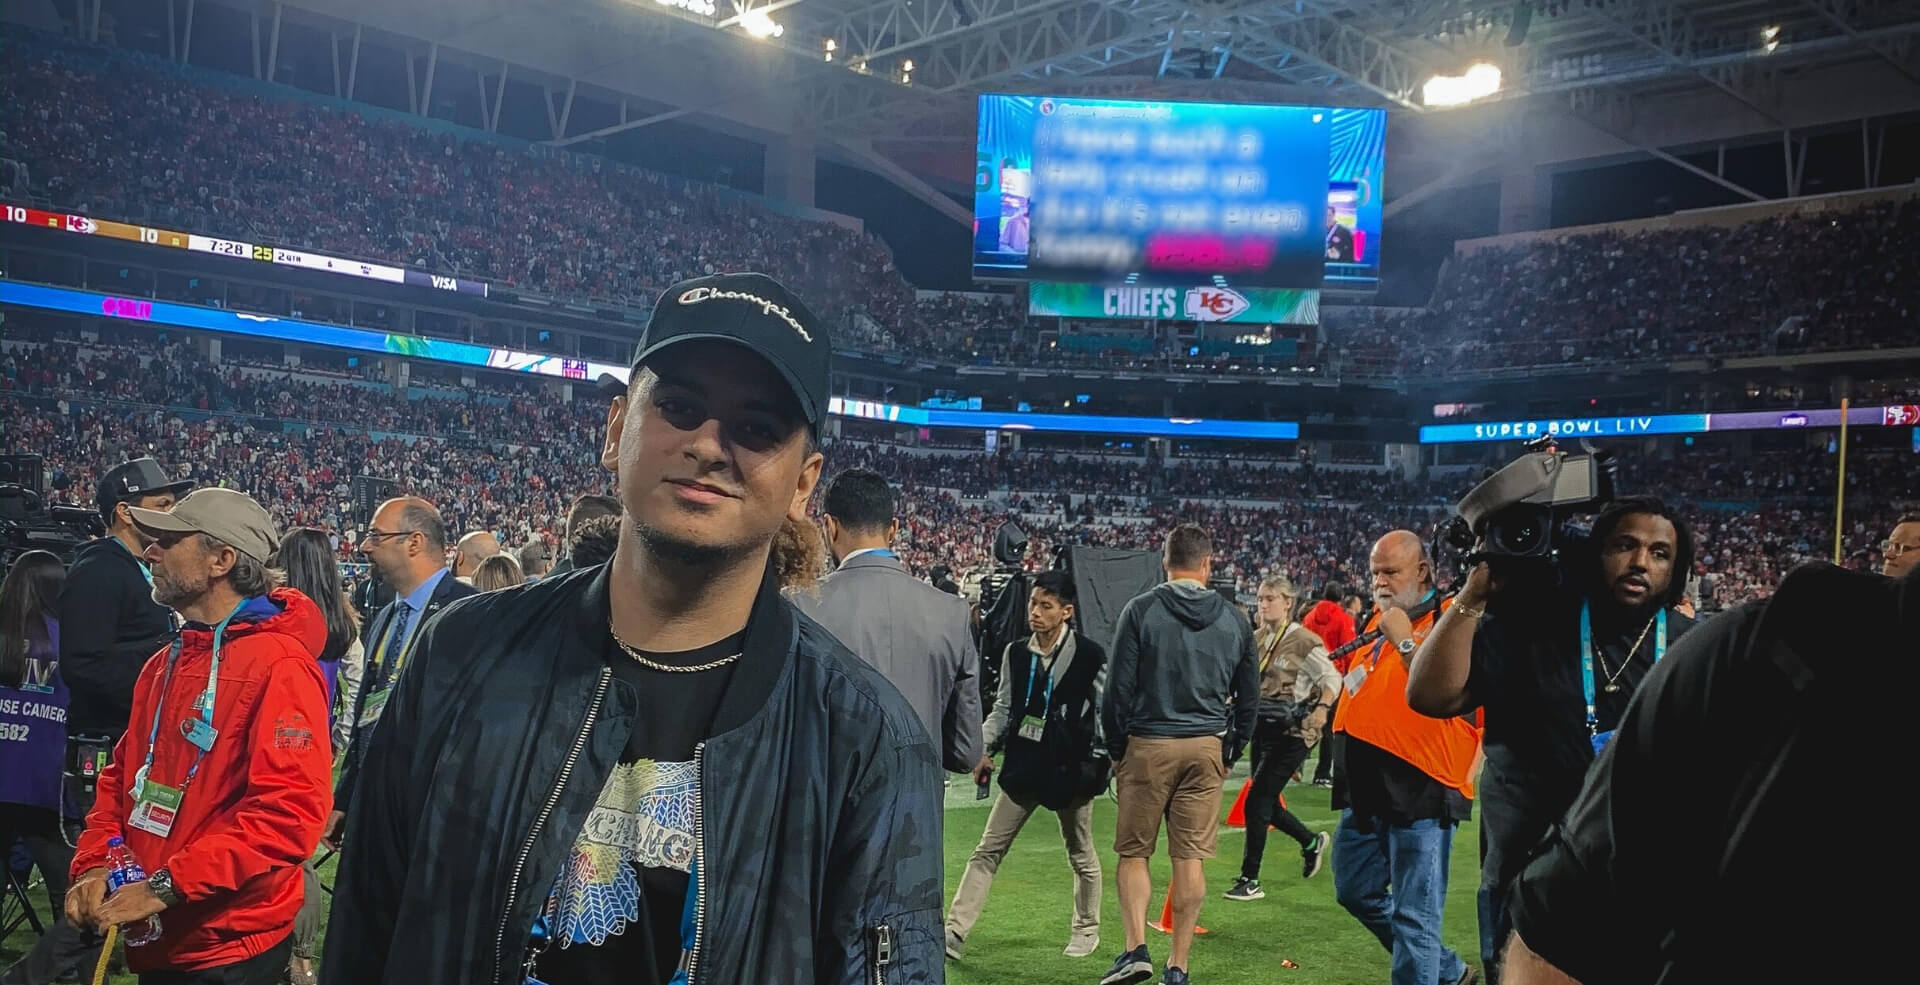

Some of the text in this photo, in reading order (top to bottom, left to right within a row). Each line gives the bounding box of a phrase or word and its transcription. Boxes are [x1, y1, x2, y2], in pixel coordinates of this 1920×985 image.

[6, 206, 26, 223] 10
[139, 227, 158, 243] 10
[210, 239, 243, 256] 7:28
[253, 246, 273, 261] 25
[430, 275, 458, 291] VISA
[1103, 287, 1177, 318] CHIEFS
[678, 287, 814, 343] Champion
[1475, 417, 1652, 438] SUPER BOWL LIV
[0, 722, 30, 742] 582
